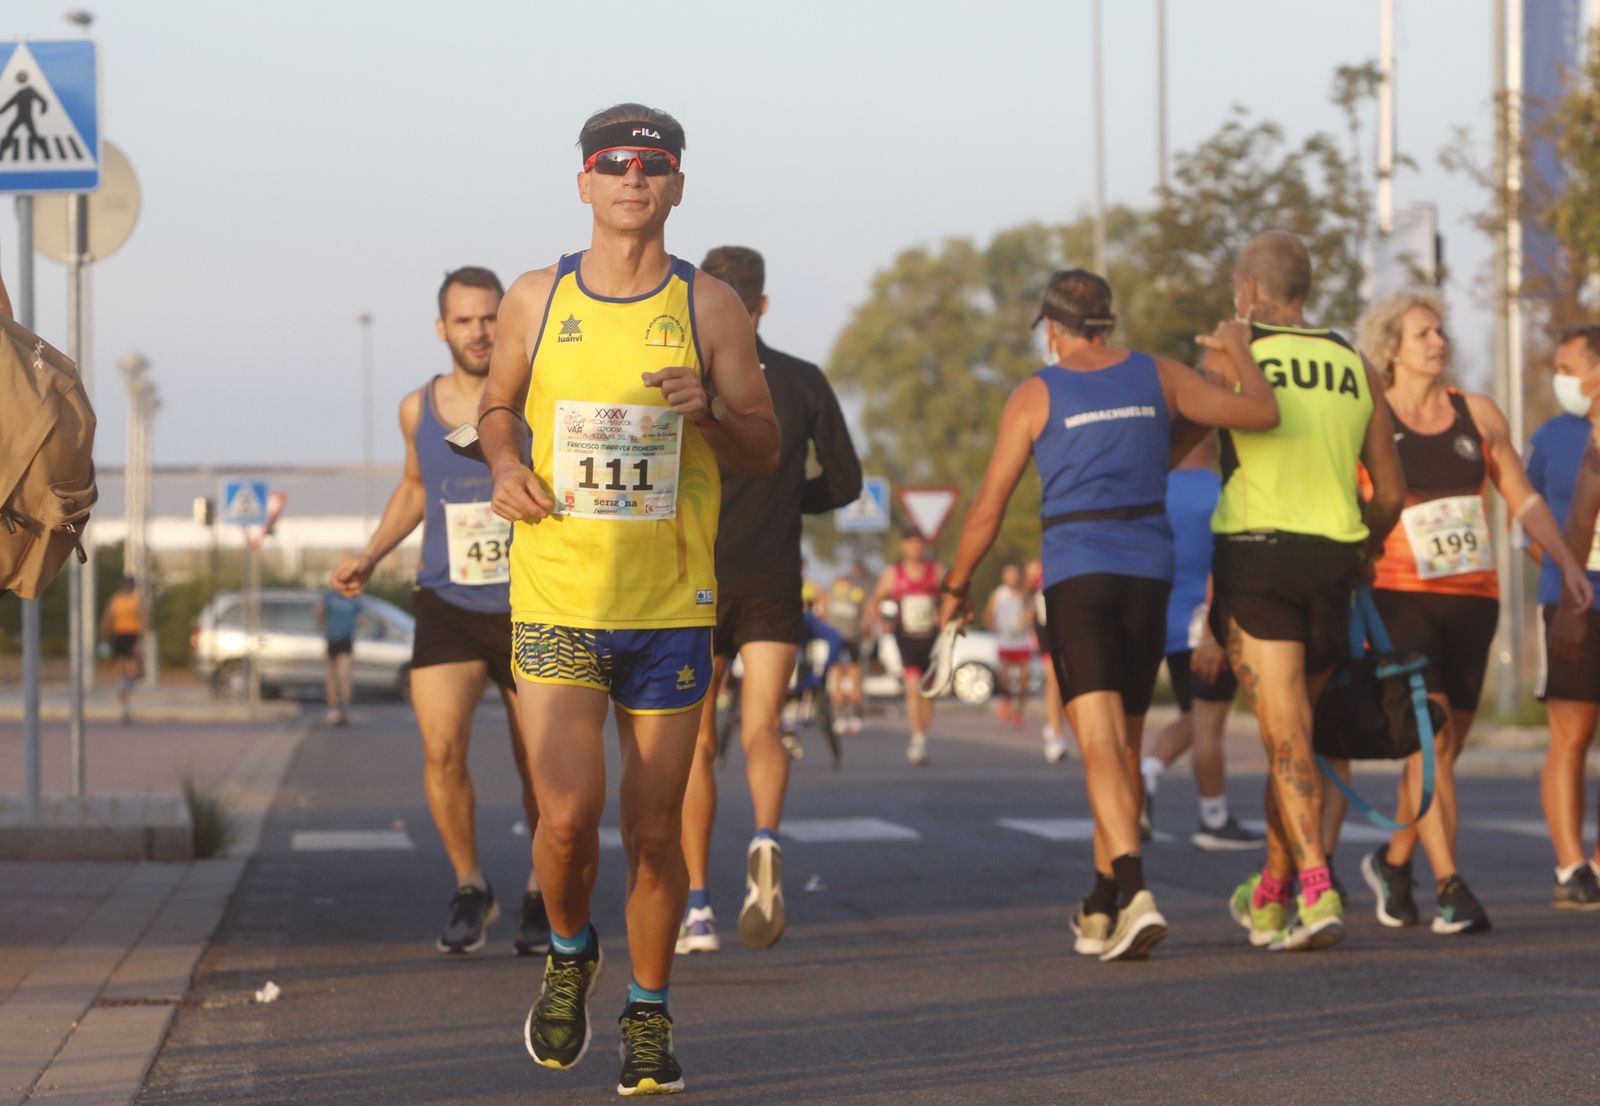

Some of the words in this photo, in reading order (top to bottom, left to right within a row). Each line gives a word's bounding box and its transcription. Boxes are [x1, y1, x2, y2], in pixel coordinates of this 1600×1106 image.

[632, 127, 661, 140] FILA
[557, 335, 583, 343] luanvi
[1257, 358, 1360, 400] GUIA
[595, 408, 628, 419] XXXV
[567, 441, 600, 450] FRANCISCO
[578, 456, 654, 491] 111
[1432, 531, 1478, 557] 199
